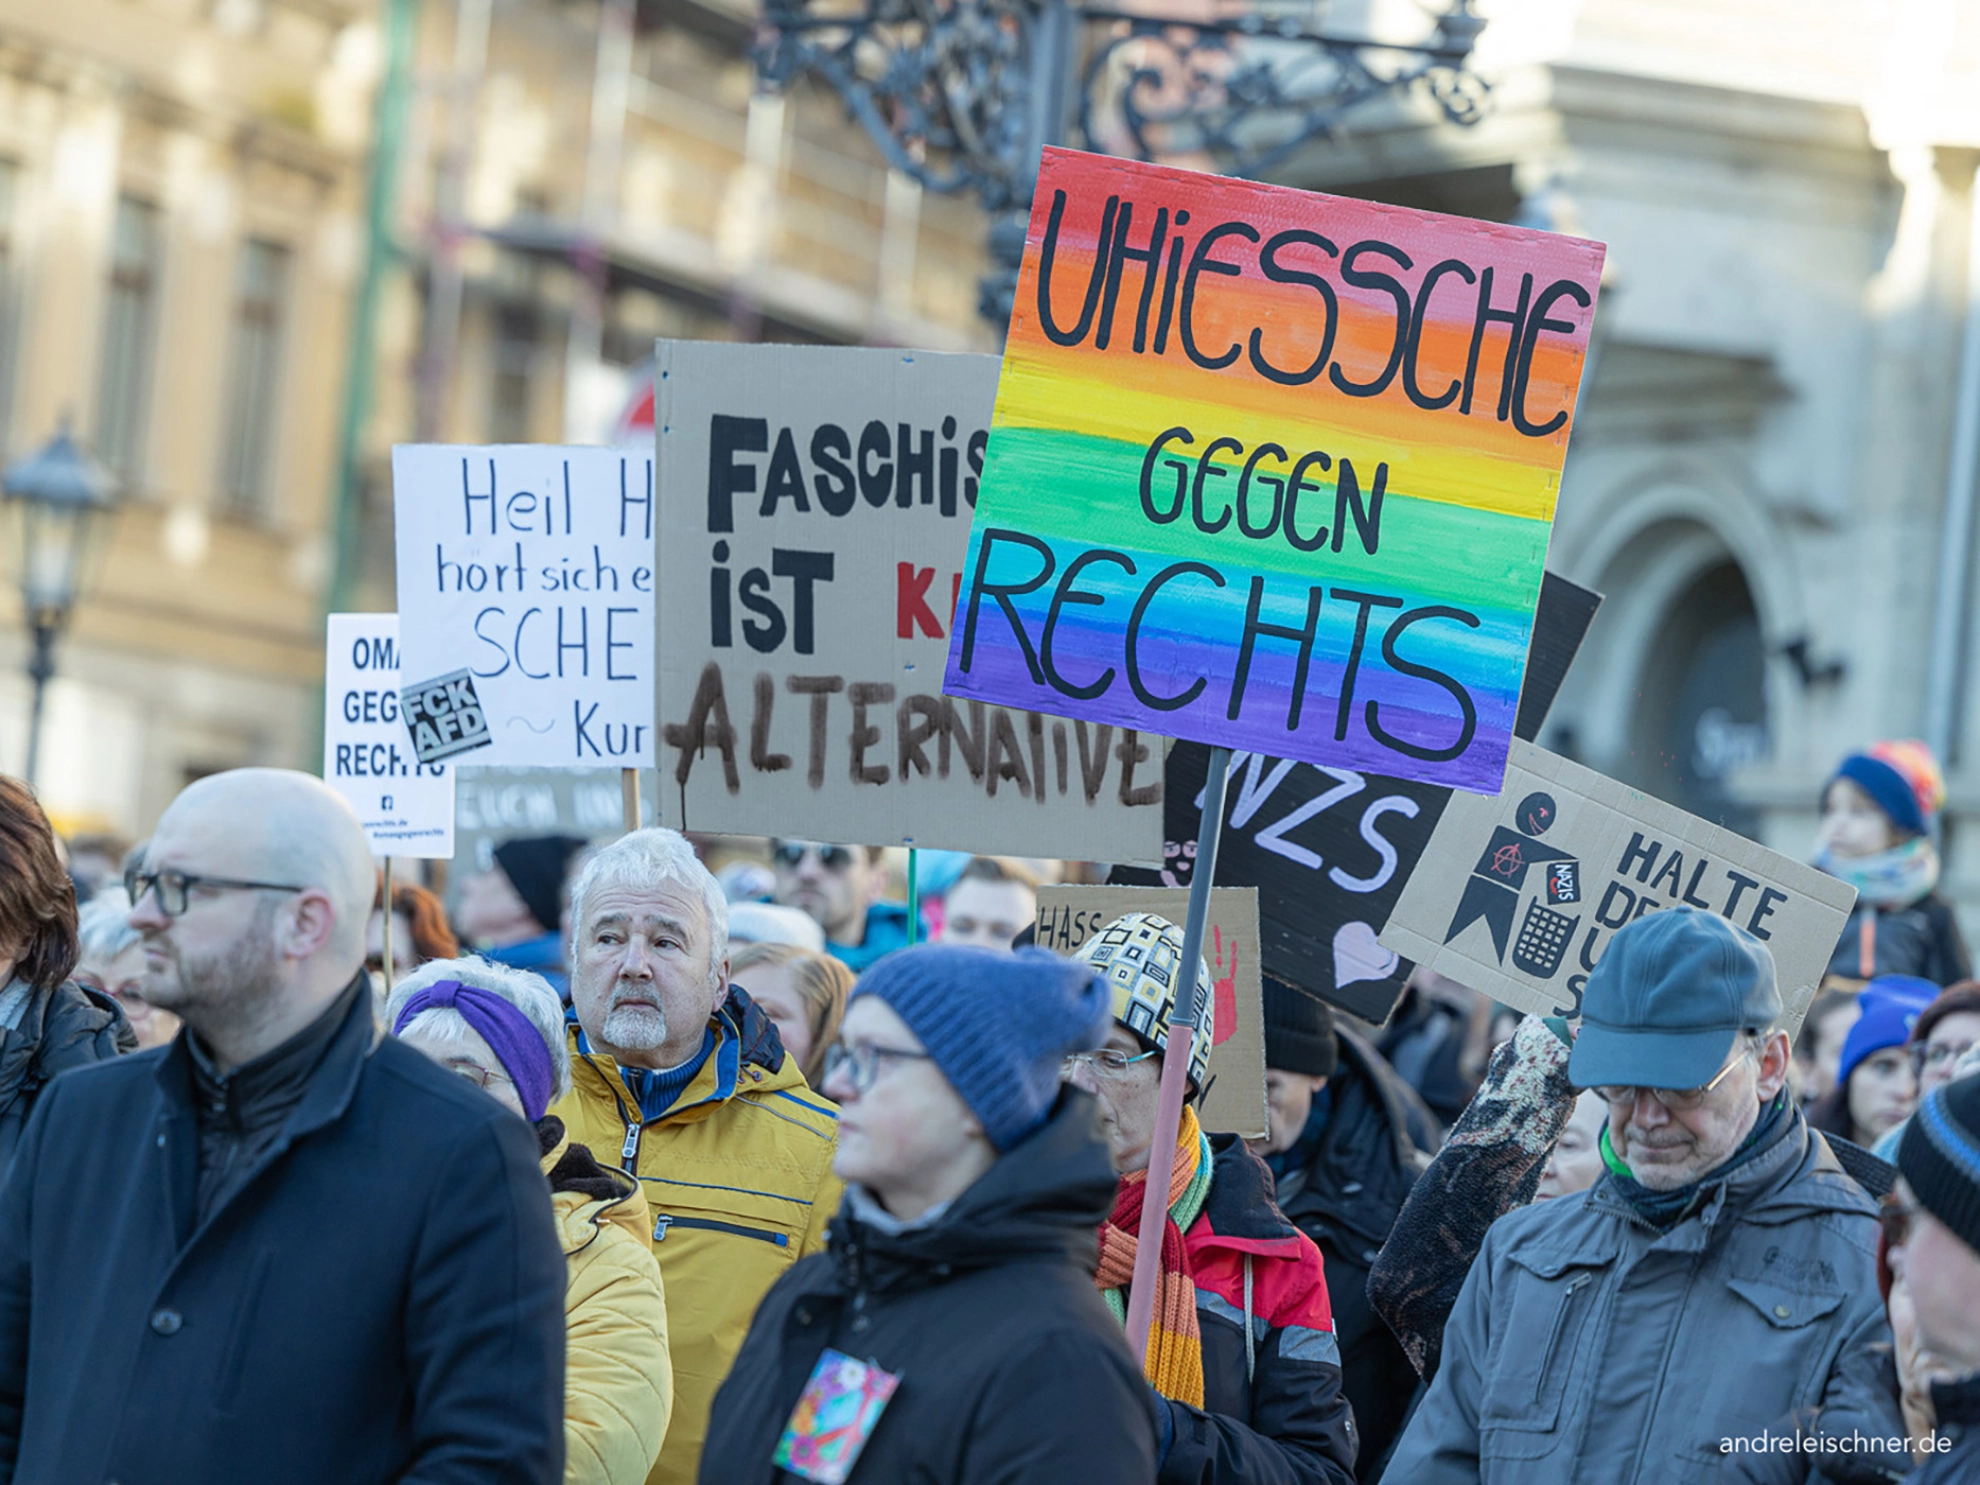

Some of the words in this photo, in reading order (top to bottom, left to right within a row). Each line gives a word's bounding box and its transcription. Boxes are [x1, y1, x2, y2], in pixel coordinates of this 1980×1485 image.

[461, 457, 571, 537] Heil
[619, 457, 652, 539] H
[1138, 426, 1389, 555] GEGEN
[436, 541, 527, 593] hört
[540, 544, 620, 593] sich
[352, 637, 400, 671] OM
[468, 605, 640, 682] SCHE
[959, 527, 1481, 762] RECHTS
[343, 690, 398, 723] GEG
[402, 678, 478, 726] FCK
[414, 705, 487, 754] AFD
[574, 699, 651, 758] Kur
[1555, 864, 1575, 901] NAZIS
[1616, 831, 1789, 942] HALTE
[1036, 904, 1102, 949] HASS
